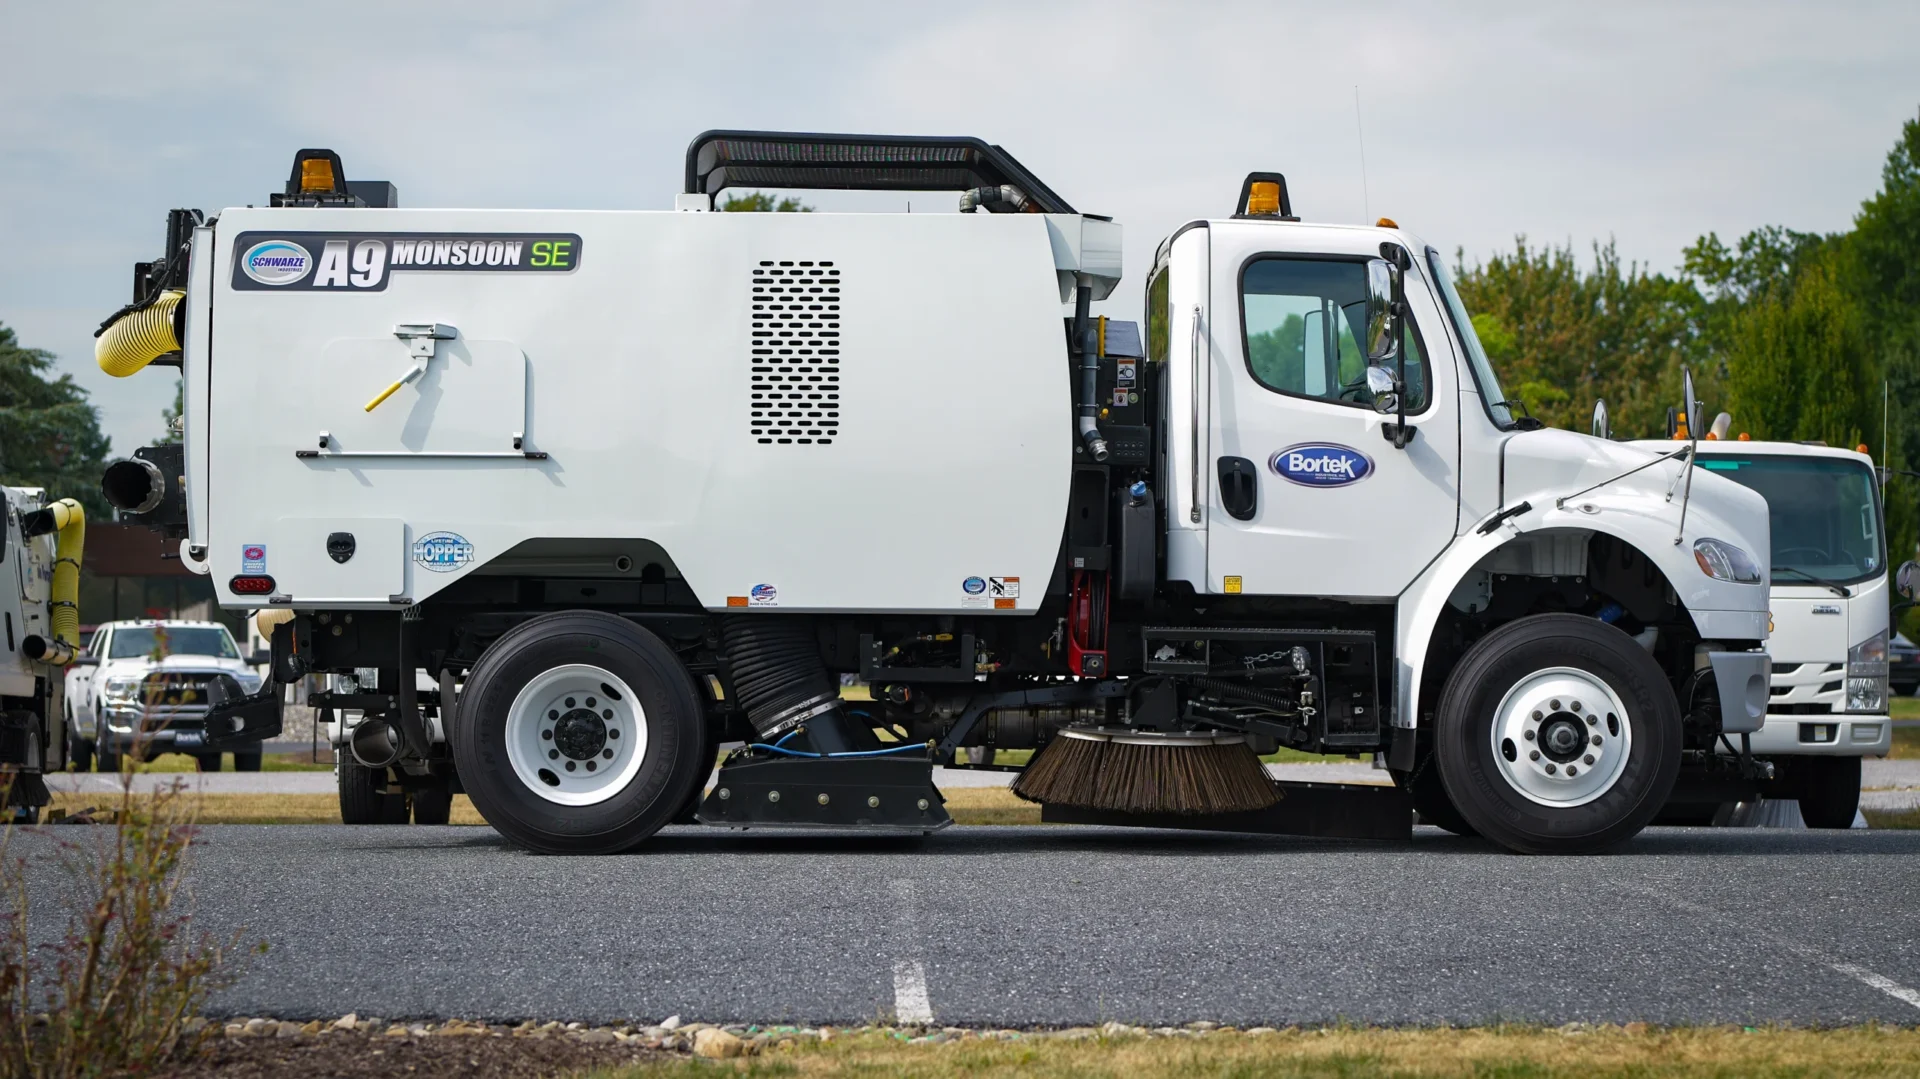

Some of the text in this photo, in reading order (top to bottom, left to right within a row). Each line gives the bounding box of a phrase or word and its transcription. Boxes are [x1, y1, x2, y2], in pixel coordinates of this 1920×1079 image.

[251, 257, 305, 267] SCHWARZE
[312, 239, 571, 288] A9 MONSOON SE
[1289, 453, 1356, 478] Bortek
[412, 543, 475, 562] HOPPER
